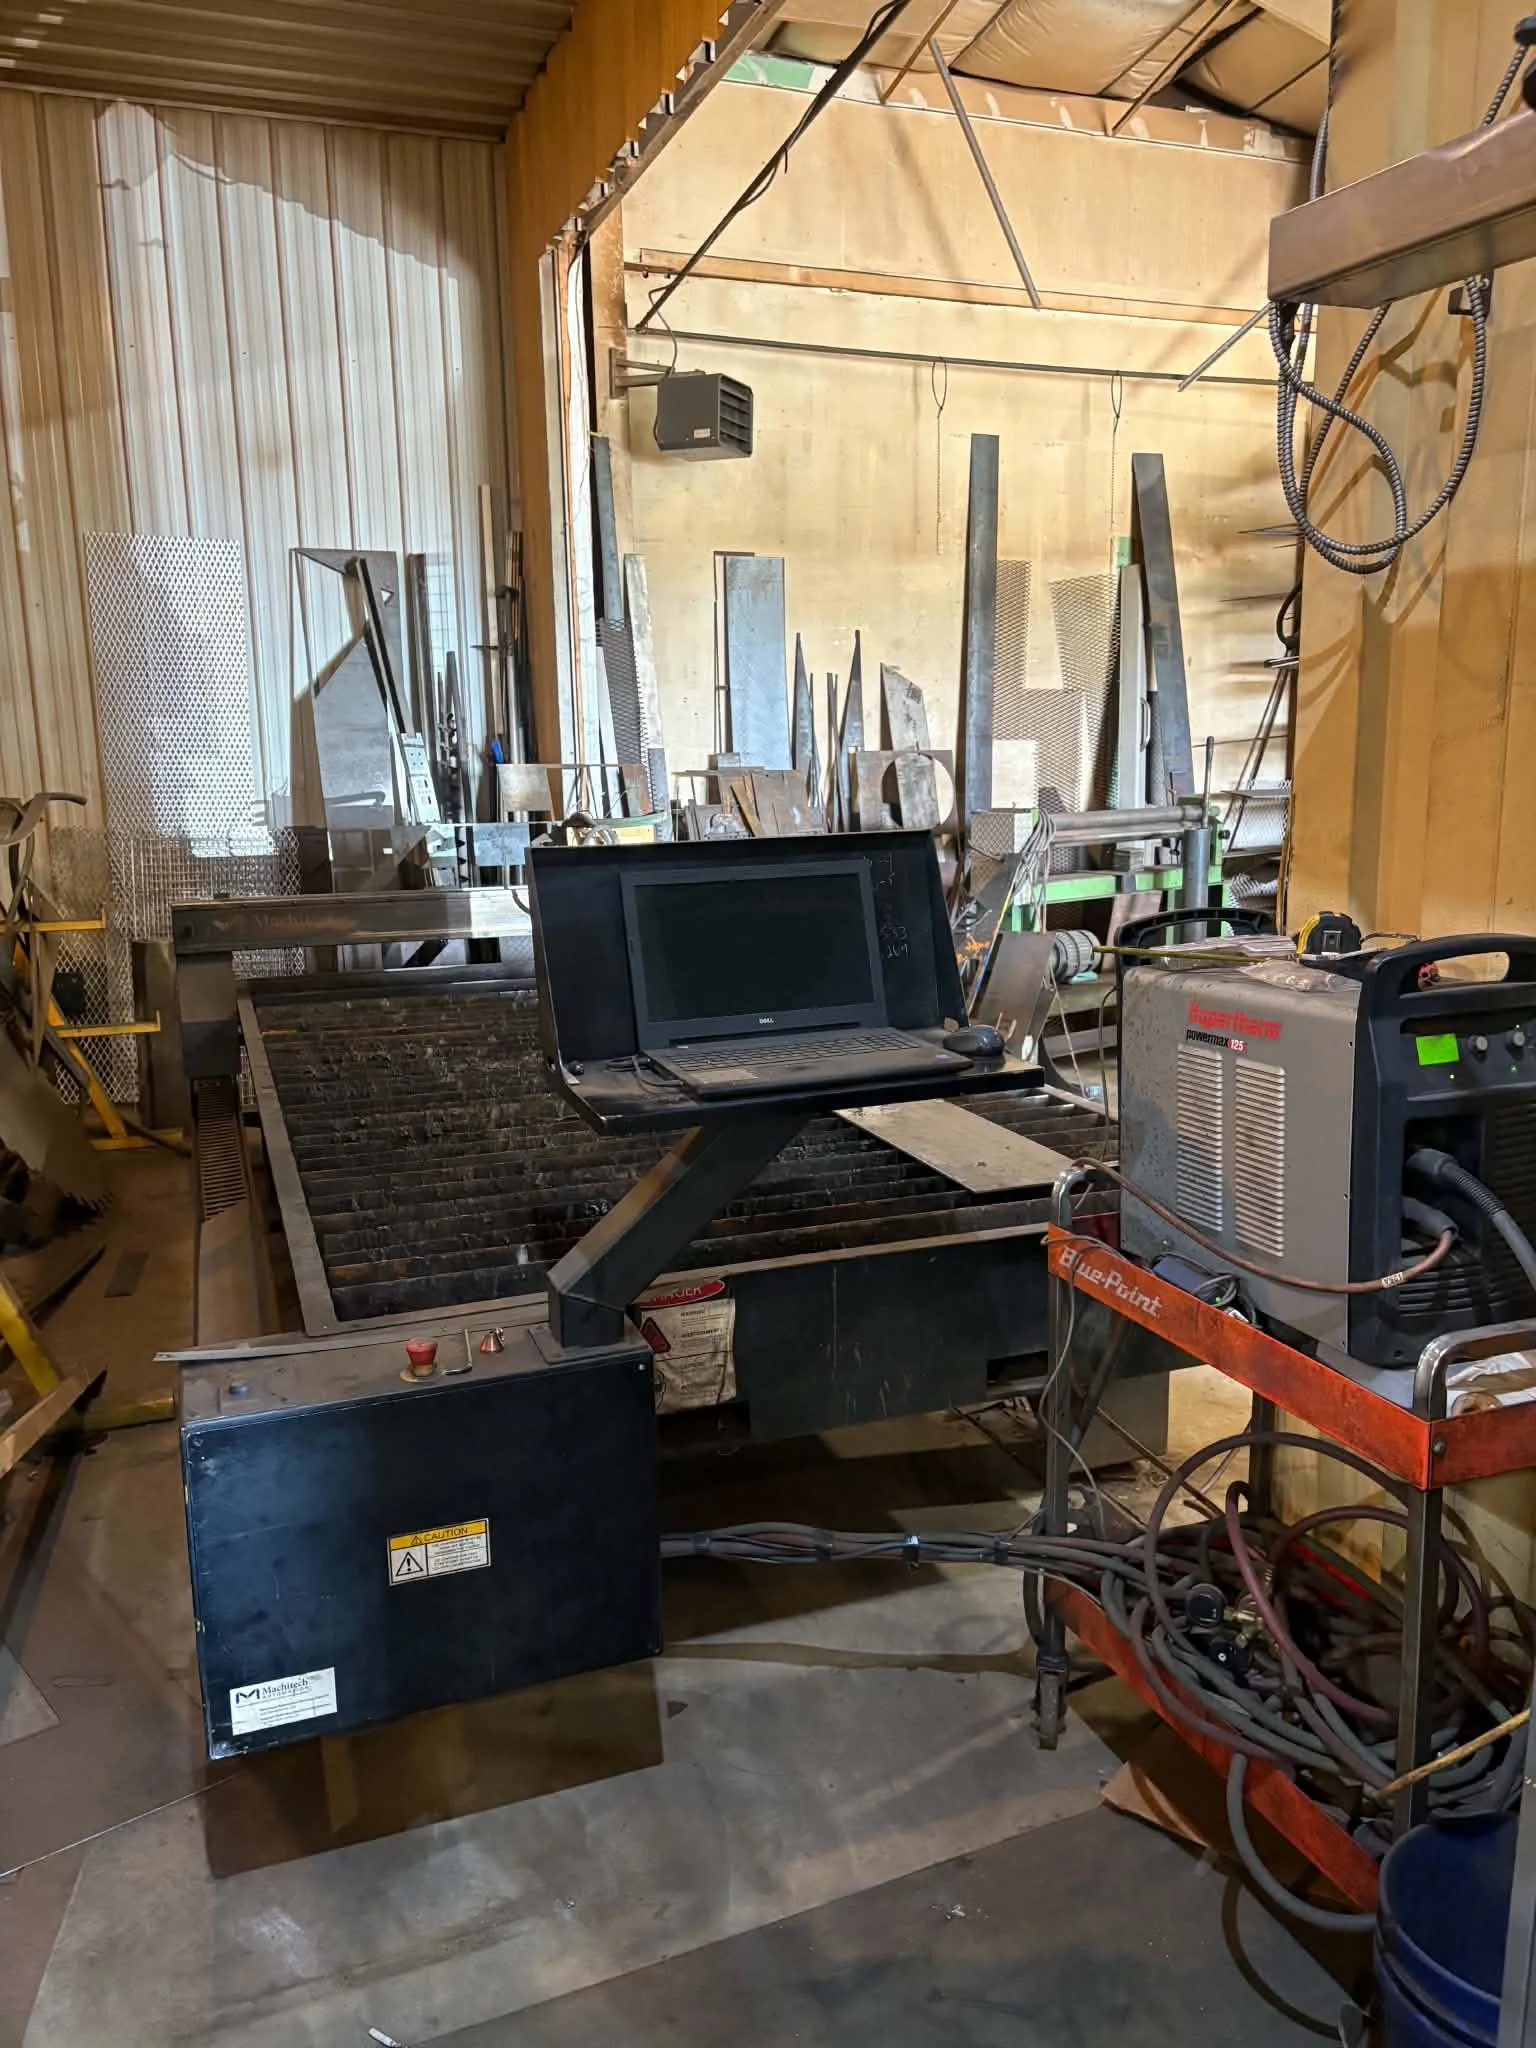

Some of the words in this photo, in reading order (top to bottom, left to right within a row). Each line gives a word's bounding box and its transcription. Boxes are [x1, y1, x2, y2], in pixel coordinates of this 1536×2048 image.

[1188, 1001, 1281, 1040] Hypertherm
[1186, 1029, 1229, 1048] powermax
[1230, 1039, 1245, 1051] 125
[424, 1527, 468, 1542] CAUTION
[262, 1677, 308, 1696] Machitech
